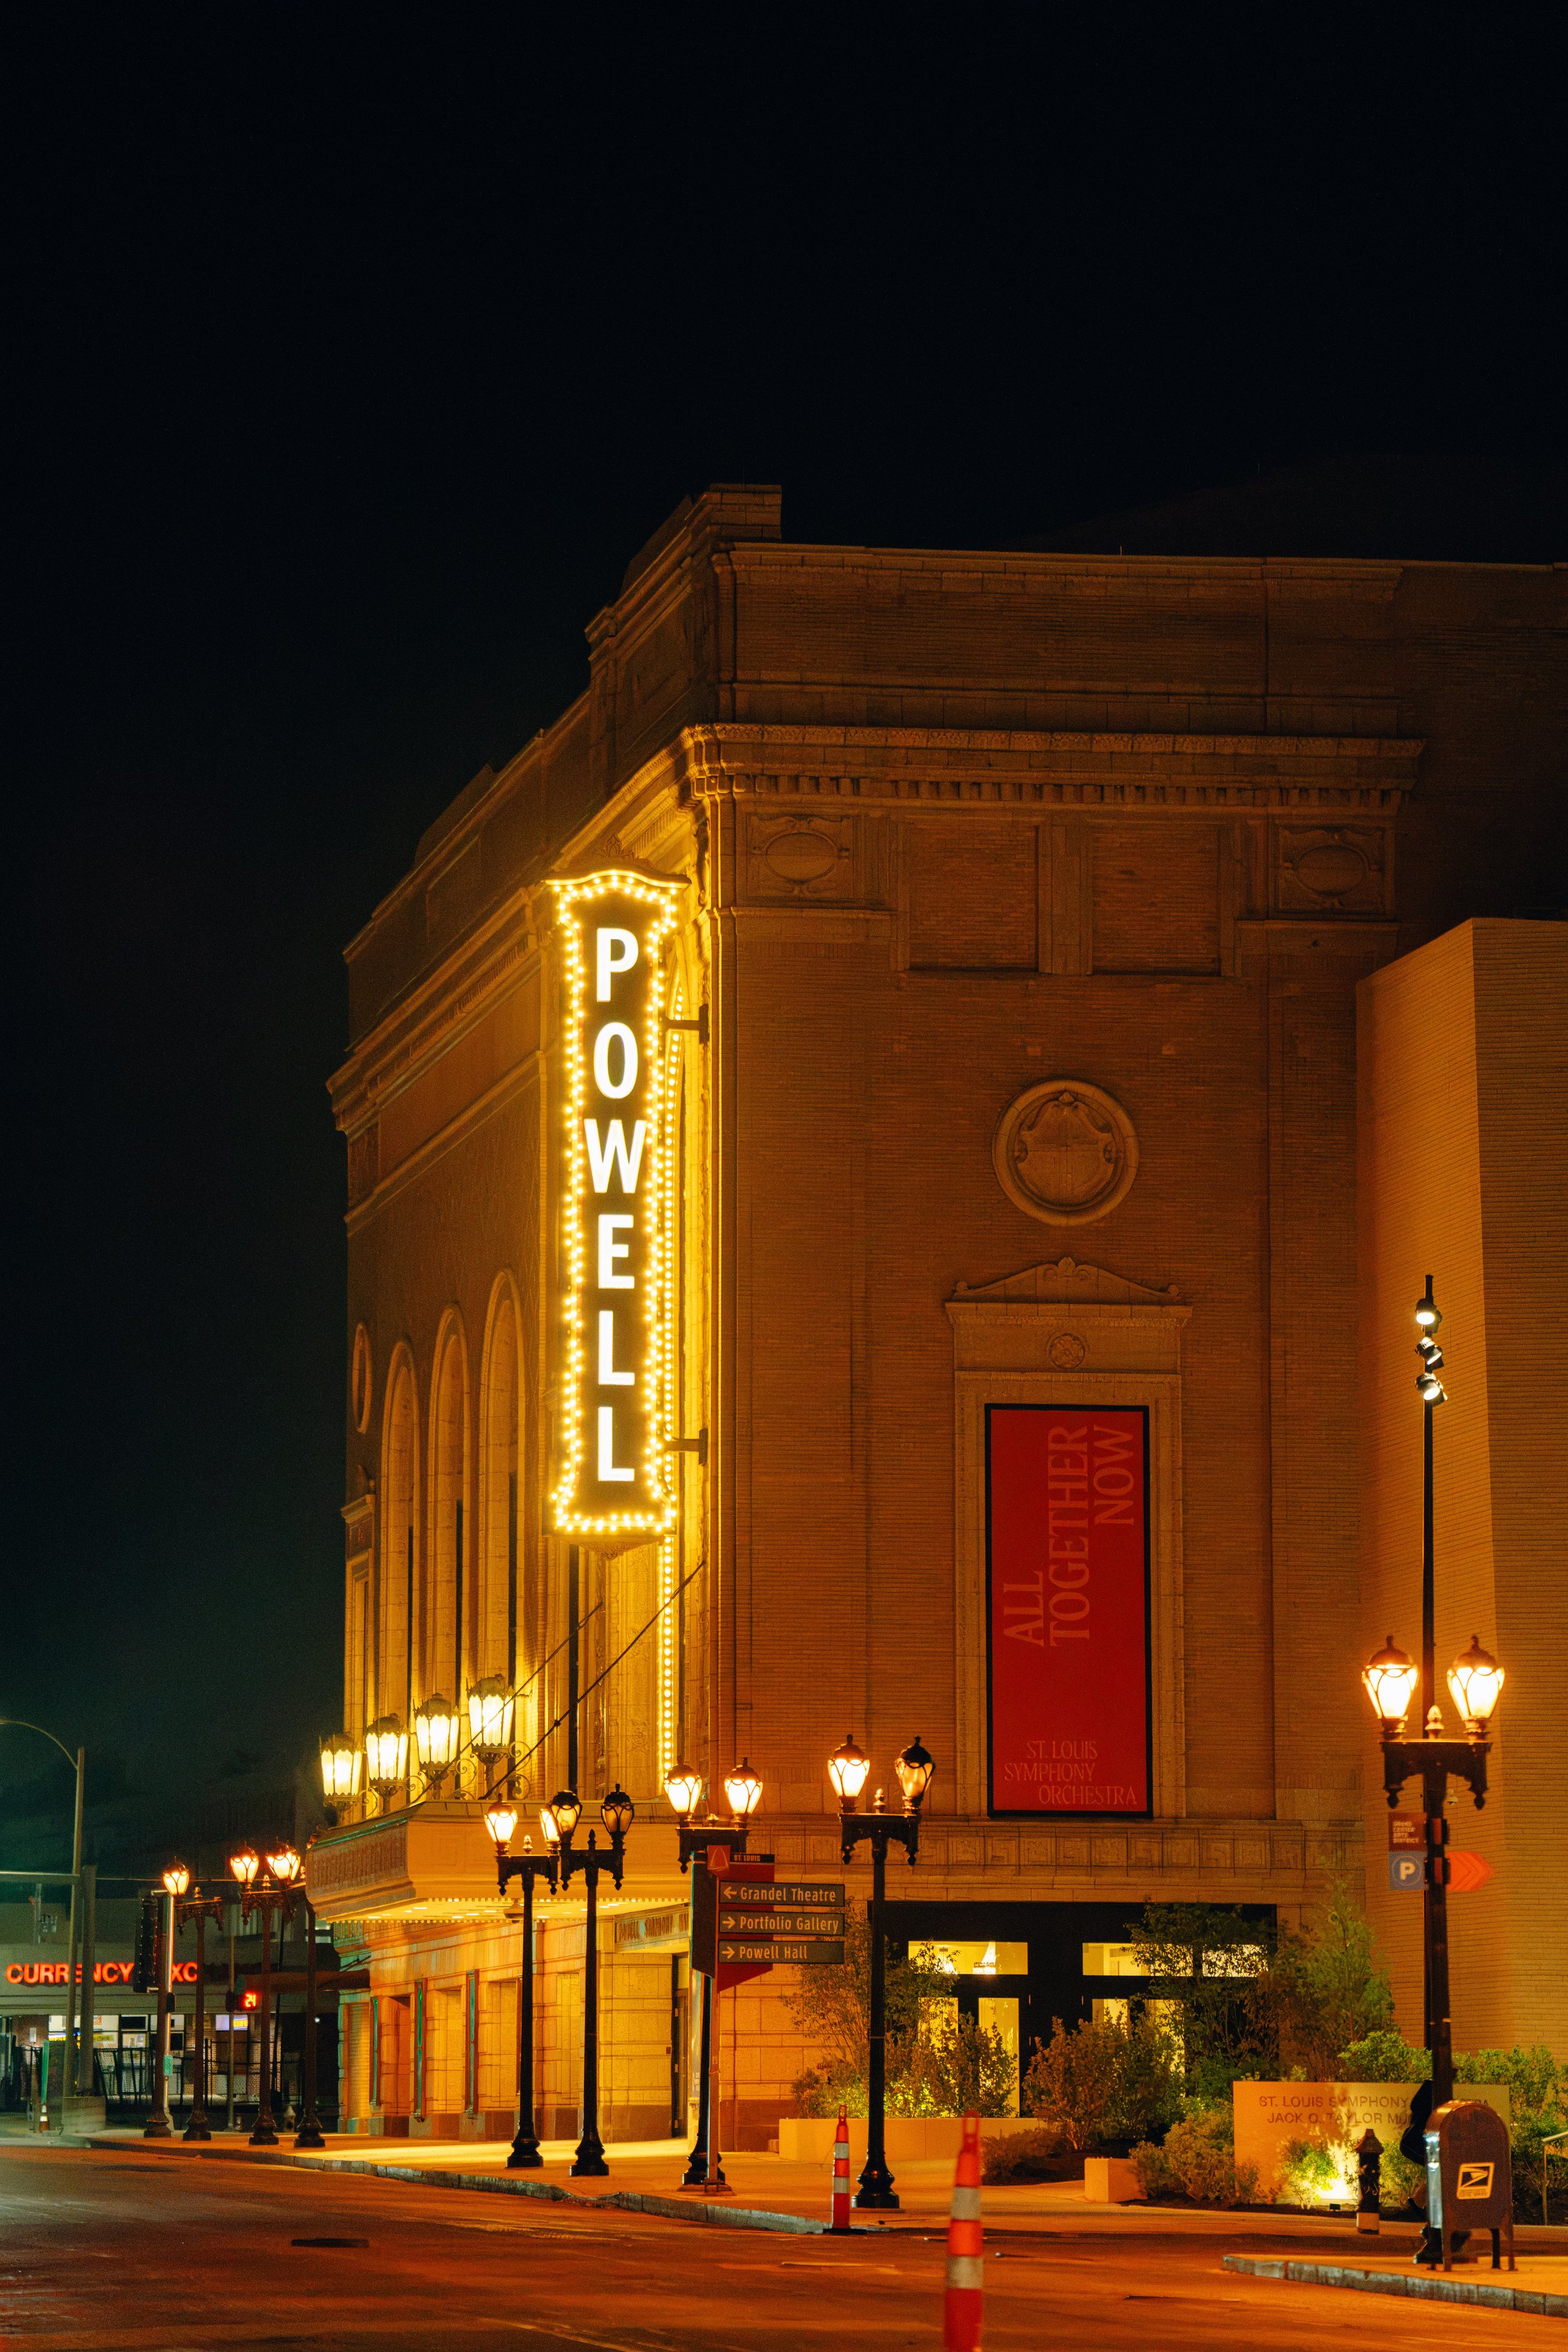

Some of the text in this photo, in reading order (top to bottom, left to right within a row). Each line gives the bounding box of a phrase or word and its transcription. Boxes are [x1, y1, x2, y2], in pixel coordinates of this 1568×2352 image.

[583, 928, 649, 1481] POWELL
[1093, 1424, 1135, 1526] NOW
[1047, 1426, 1090, 1647] TOGETHER
[1003, 1571, 1044, 1648] ALL
[1027, 1740, 1098, 1760] ST. LOUIS
[1004, 1762, 1096, 1782] SYMPHONY
[1039, 1784, 1138, 1805] ORCHESTRA
[1399, 1862, 1416, 1880] P
[740, 1887, 836, 1902] Grandel Theatre
[740, 1915, 839, 1934] Portfolio Gallery
[739, 1946, 808, 1959] Powell Hall
[5, 1962, 135, 1984] CURRENCY
[245, 1993, 257, 2007] 24
[1259, 2096, 1409, 2108] ST. LOUIS SYMPHONY
[1267, 2112, 1303, 2124] JACK
[1324, 2112, 1382, 2124] TAYLOR
